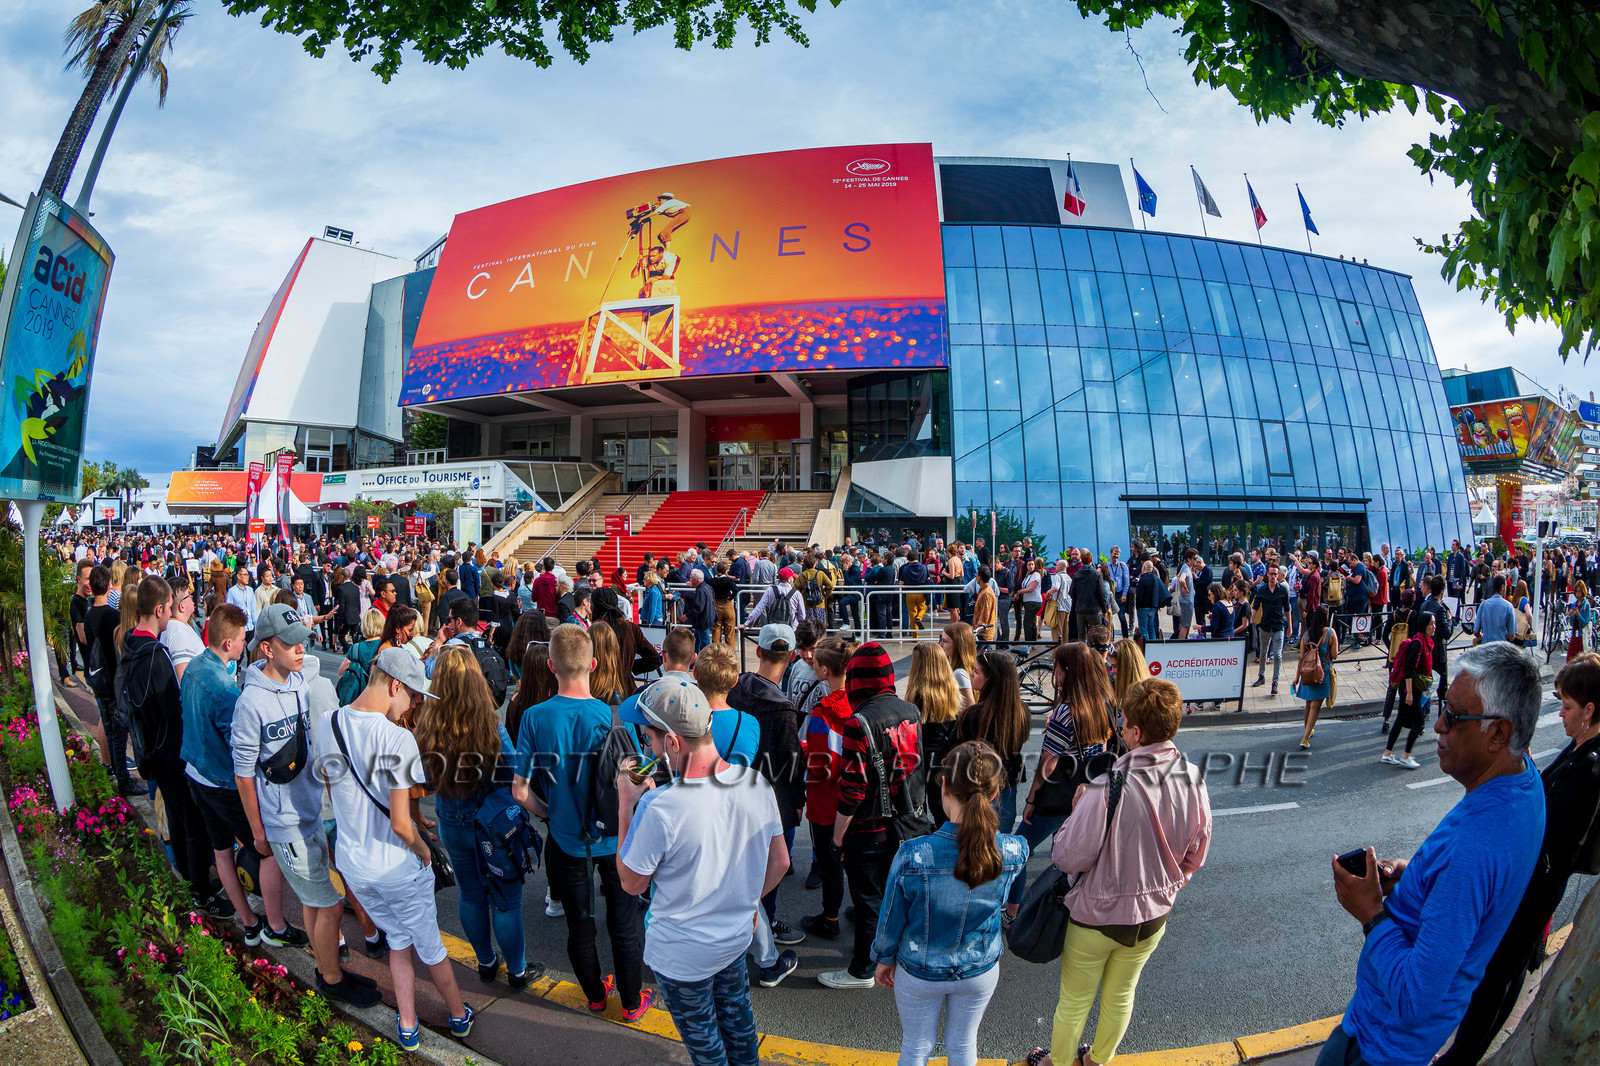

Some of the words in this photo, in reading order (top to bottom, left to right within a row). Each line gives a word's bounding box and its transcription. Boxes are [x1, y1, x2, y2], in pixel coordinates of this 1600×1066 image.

[472, 260, 503, 271] FESTIVAL
[506, 247, 562, 263] INTERNATIONAL
[579, 240, 597, 248] FILM
[29, 288, 77, 331] CANNES
[23, 309, 55, 340] 2019
[377, 474, 407, 486] OFFICE
[422, 471, 472, 483] TOURISME
[1165, 669, 1224, 679] REGISTRATION
[1166, 657, 1238, 668] ACCRÉDITATIONS
